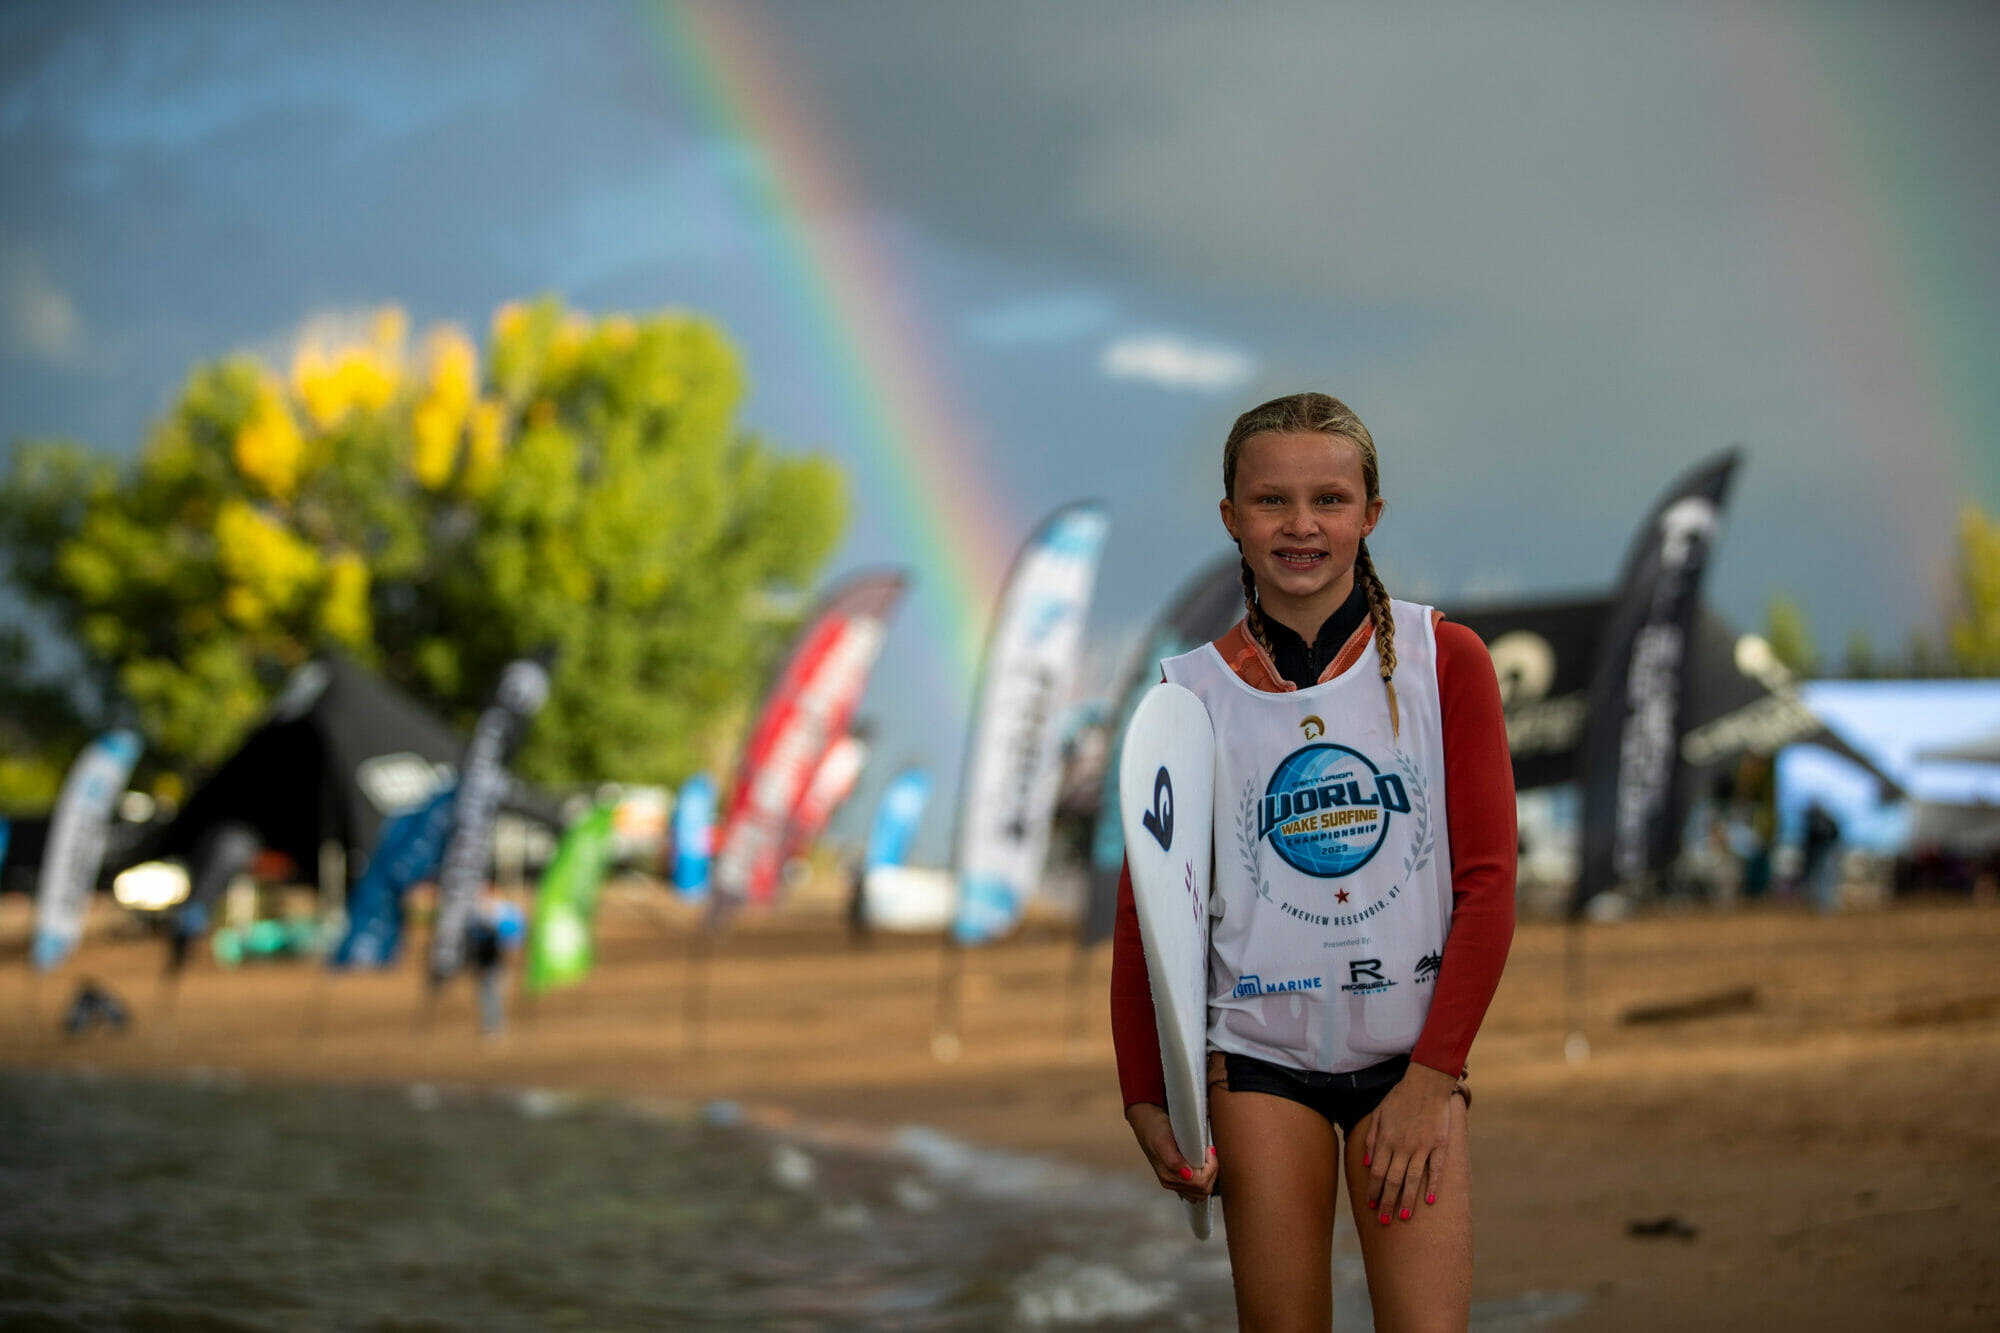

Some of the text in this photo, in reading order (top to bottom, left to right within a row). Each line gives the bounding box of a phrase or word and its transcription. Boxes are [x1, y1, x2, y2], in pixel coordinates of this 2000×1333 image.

[1257, 773, 1411, 842] WORLD
[1281, 809, 1378, 836] WAKE SURFING
[1286, 824, 1378, 846] CHAMPIONSHIP
[1321, 844, 1348, 856] 2023
[1281, 902, 1329, 926] PINEVIEW
[1389, 885, 1400, 898] UT
[1323, 938, 1359, 949] Presented
[1267, 977, 1322, 993] MARINE
[1341, 979, 1398, 991] ROSWELL
